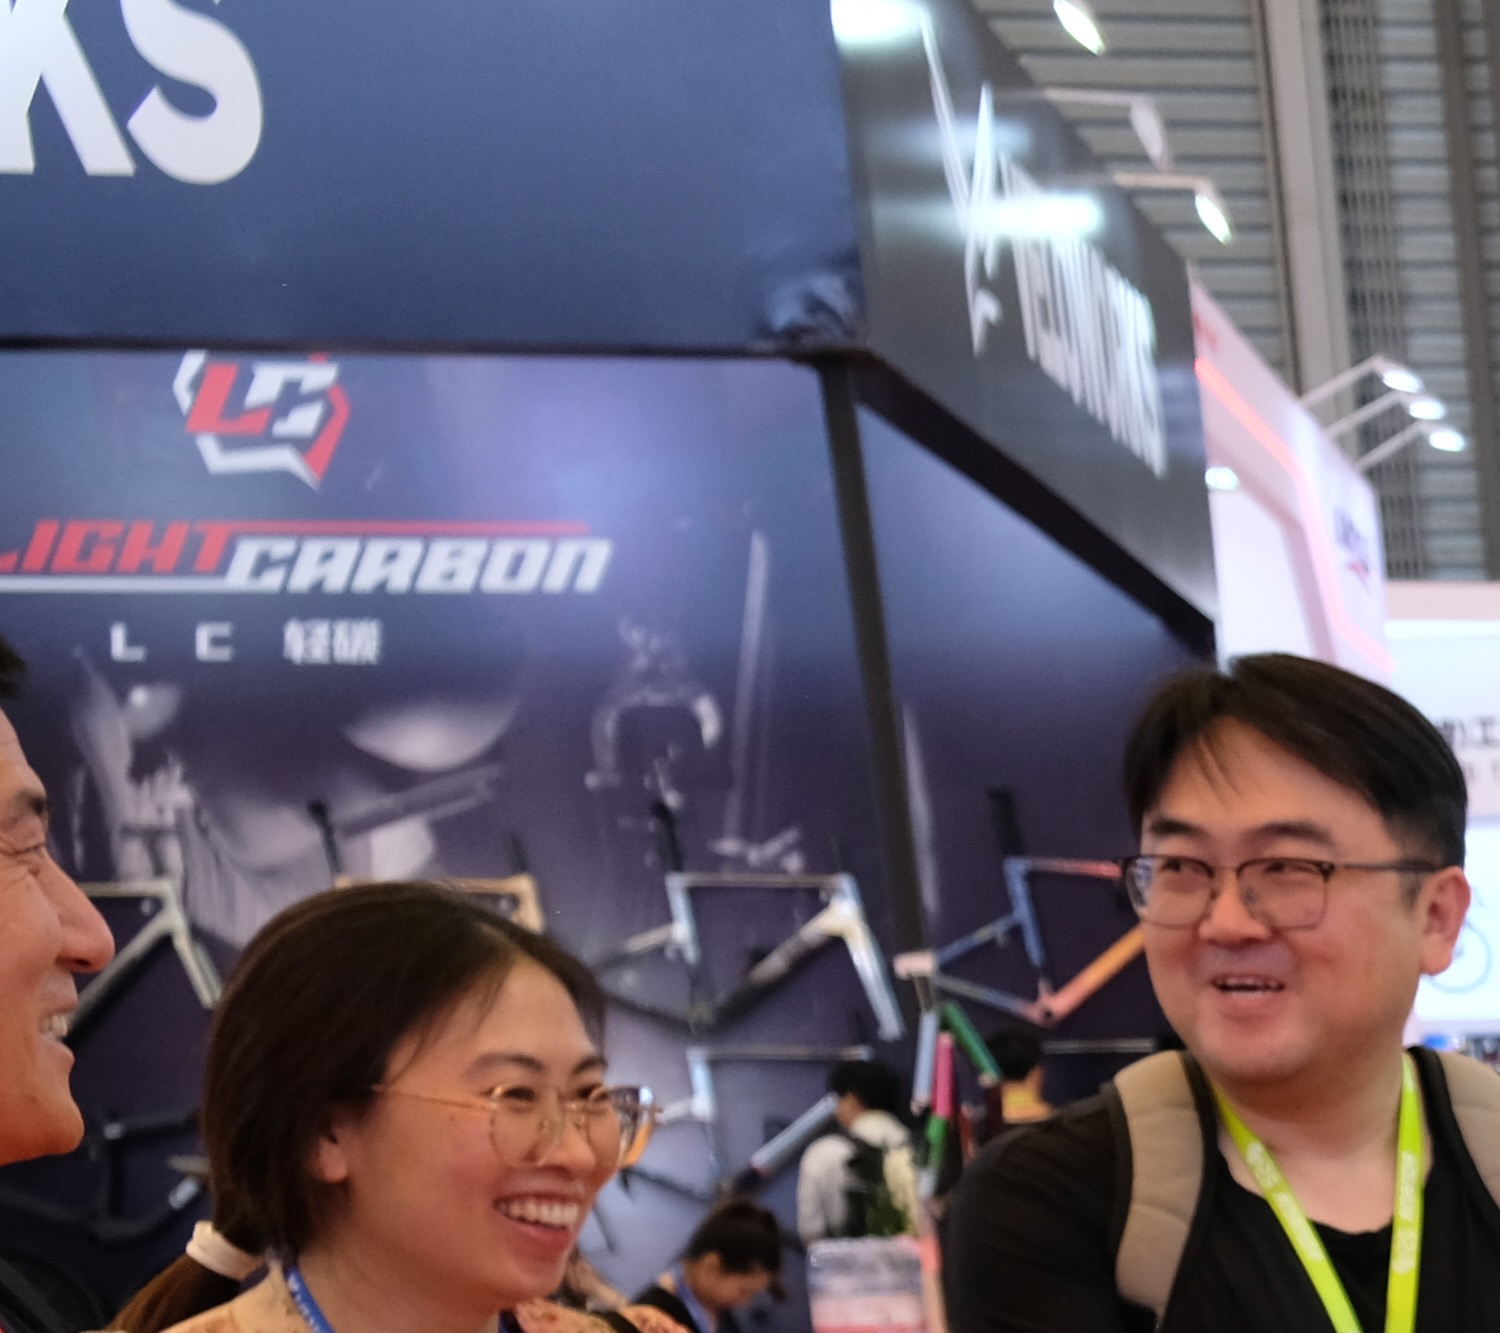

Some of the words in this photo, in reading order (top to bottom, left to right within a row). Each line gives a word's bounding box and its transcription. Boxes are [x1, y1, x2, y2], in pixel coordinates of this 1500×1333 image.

[0, 519, 233, 574] IGHT
[225, 537, 613, 595] CARBON
[110, 621, 147, 662] L
[196, 622, 235, 662] C
